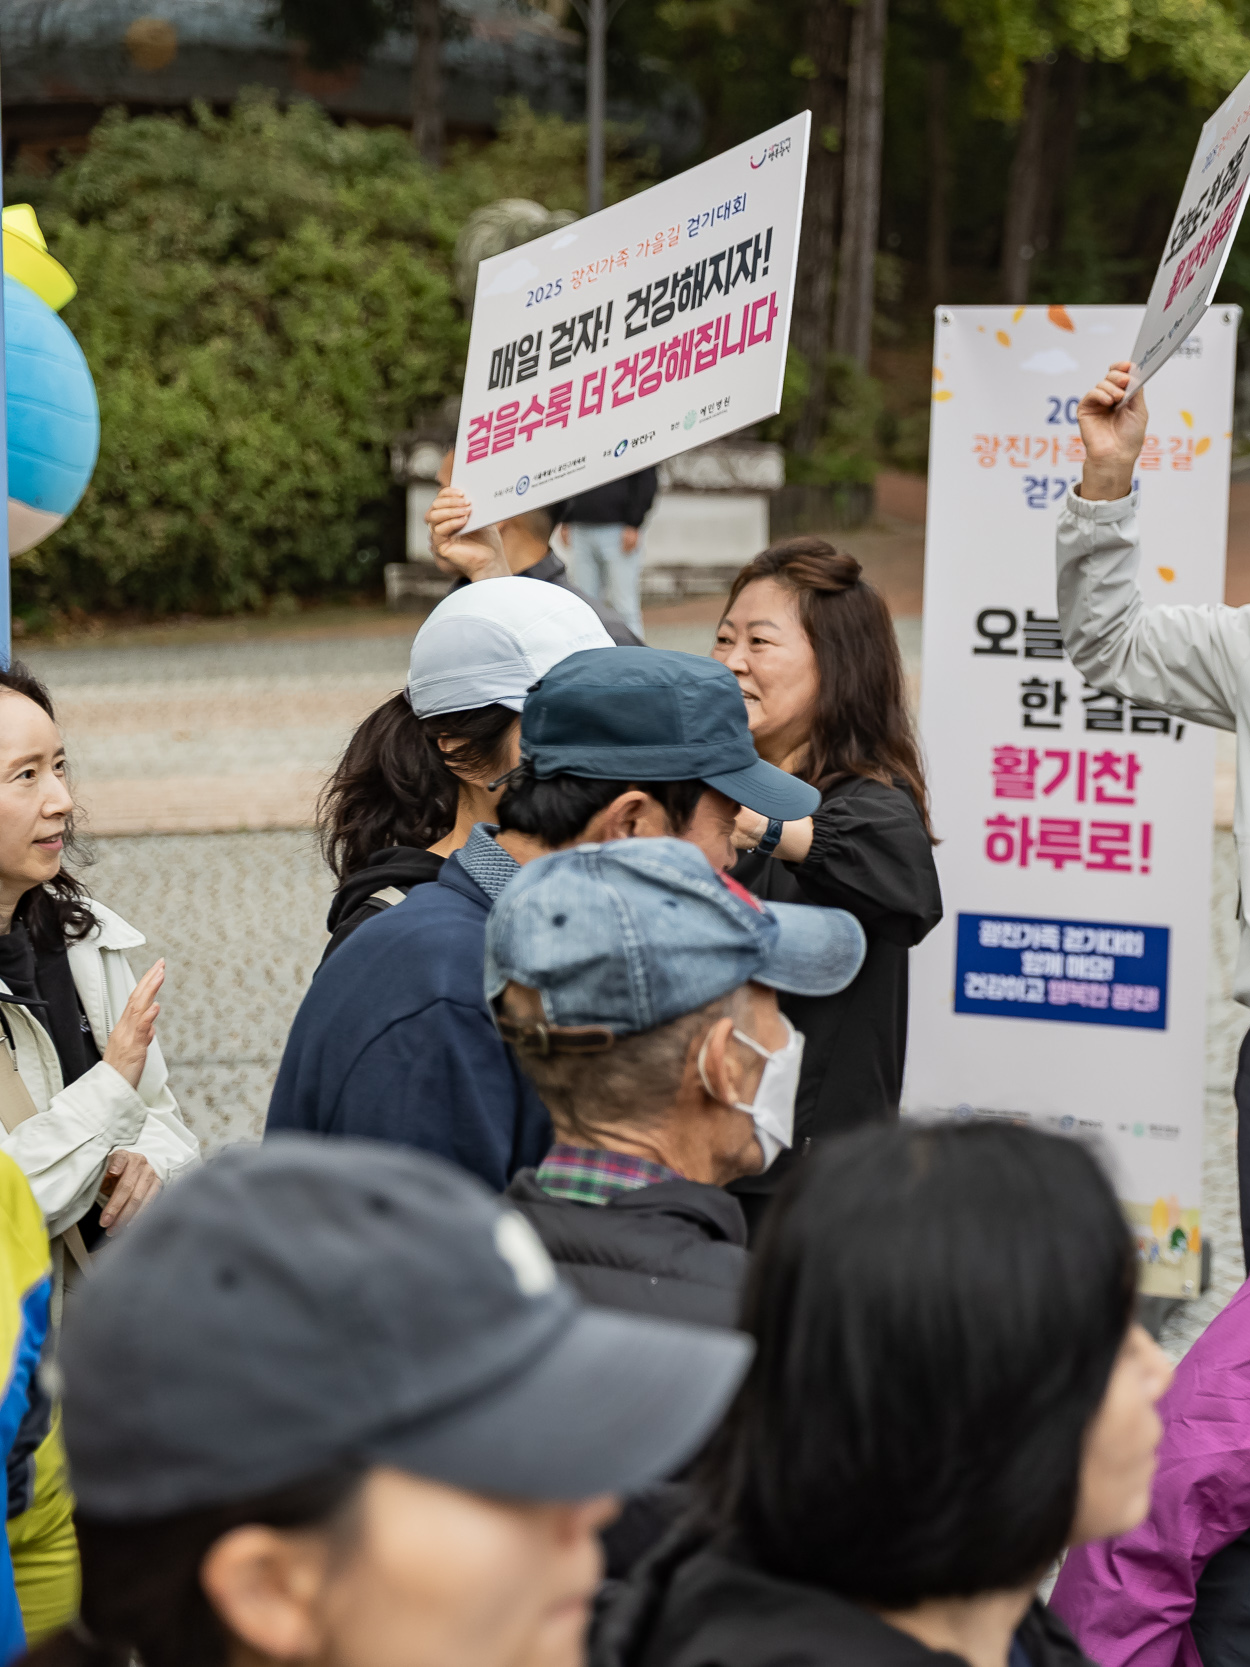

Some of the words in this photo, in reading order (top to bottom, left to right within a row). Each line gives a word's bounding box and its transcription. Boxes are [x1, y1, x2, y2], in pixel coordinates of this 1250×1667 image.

[525, 278, 563, 308] 2025
[570, 248, 629, 290] 광진가족
[636, 224, 681, 257] 가을길
[686, 192, 747, 238] 걷기대회
[488, 330, 543, 391] 매일
[549, 299, 614, 372] 걷자!
[624, 226, 774, 339] 건강해지자!
[466, 380, 573, 465] 걸을수록
[577, 366, 607, 419] 더
[611, 290, 779, 409] 건강해집니다
[1046, 396, 1080, 425] 20
[1140, 435, 1194, 471] 을길
[973, 609, 1064, 659] 오늘
[1020, 678, 1067, 729] 한
[992, 746, 1141, 805] 활기찬
[985, 814, 1152, 874] 하루로!
